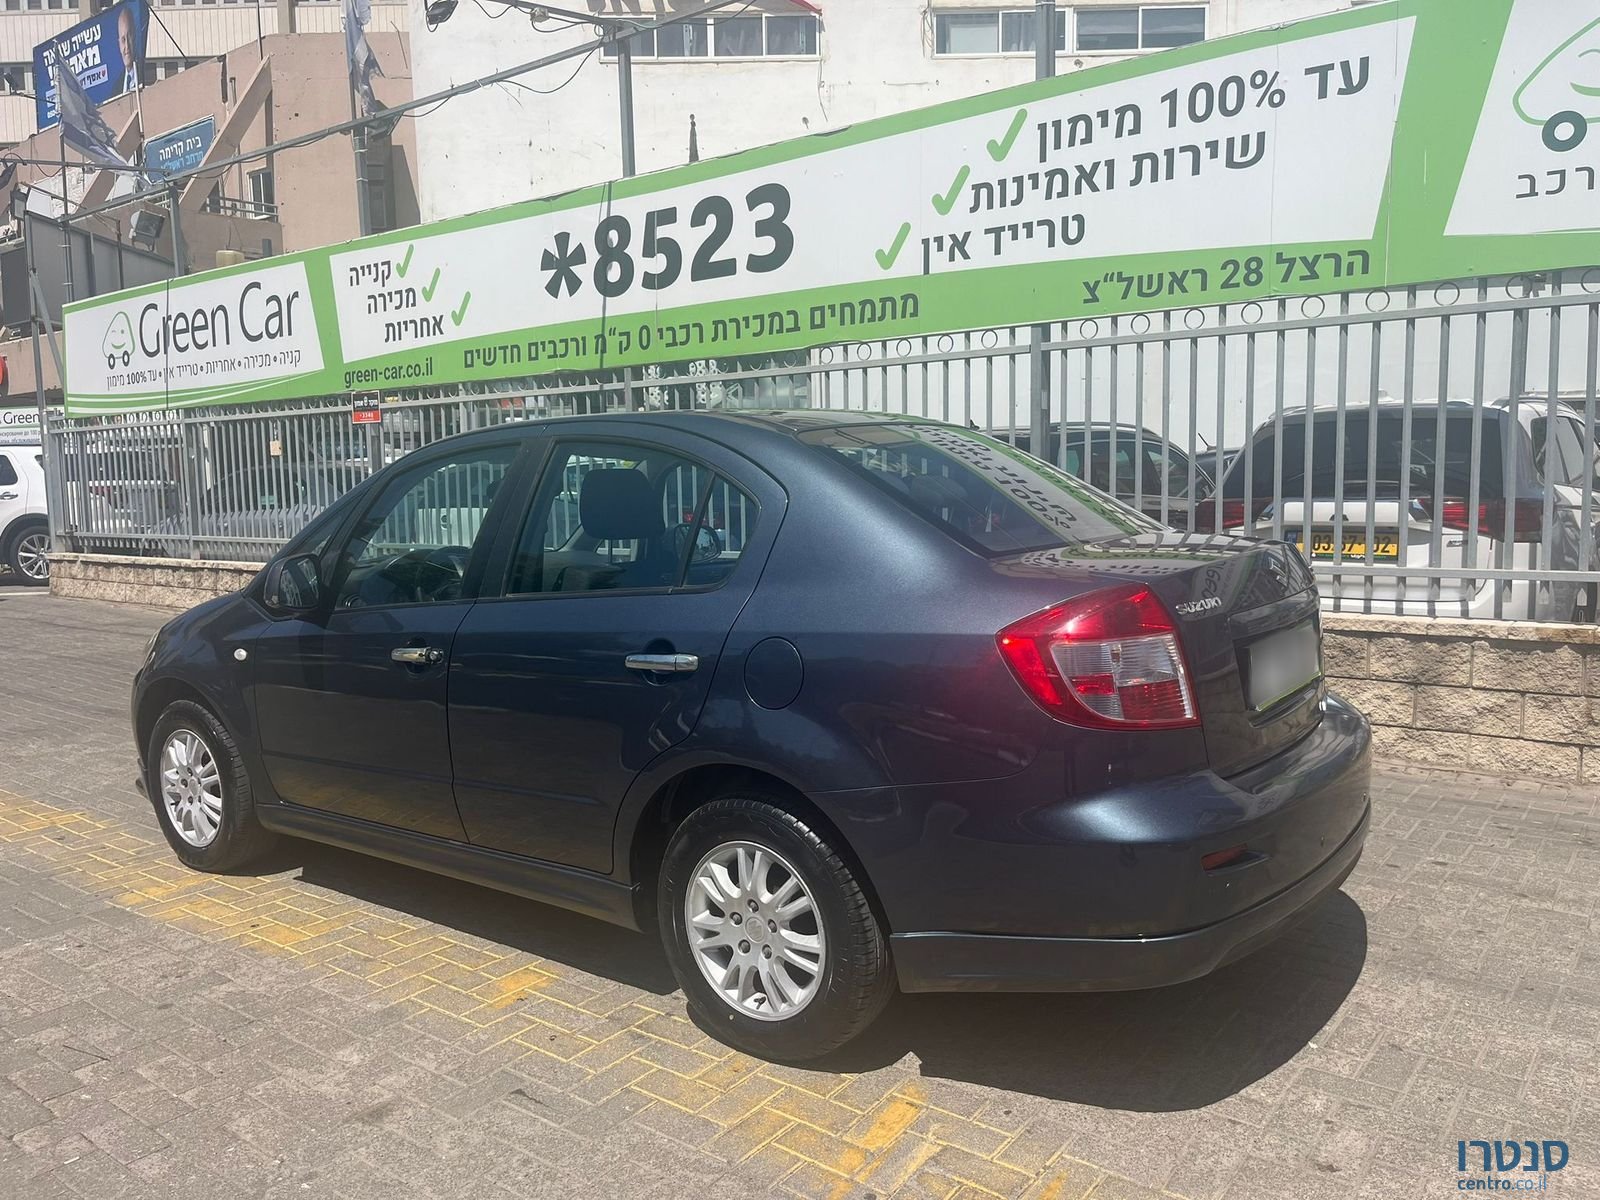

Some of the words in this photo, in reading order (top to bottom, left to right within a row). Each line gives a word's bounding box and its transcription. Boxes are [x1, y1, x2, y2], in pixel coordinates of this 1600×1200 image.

[1304, 56, 1370, 100] עד
[1160, 69, 1286, 129] 100%
[1037, 104, 1142, 163] מימון
[1129, 131, 1266, 187] שירות
[969, 158, 1115, 213] ואמינות
[1516, 166, 1595, 199] רכב
[984, 214, 1085, 256] טרייד
[921, 231, 972, 275] אין
[1275, 250, 1370, 283] הרצל
[349, 260, 391, 287] קנייה
[1220, 256, 1264, 289] 28
[367, 287, 417, 314] מכירה
[809, 293, 919, 330] מתמחים
[139, 303, 230, 358] Green
[239, 281, 299, 342] Car
[384, 314, 444, 343] אחריות
[657, 322, 704, 348] רכבי
[711, 309, 801, 342] במכירת
[527, 336, 587, 362] ורכבים
[638, 325, 651, 350] 0
[205, 357, 236, 375] אחריות
[243, 353, 271, 369] מכירה
[279, 349, 301, 368] קניה
[464, 344, 521, 368] חדשים
[127, 371, 147, 386] 100%
[344, 357, 433, 388] green-car.co.il
[3, 411, 40, 424] Green
[1175, 596, 1222, 614] SUZUKI
